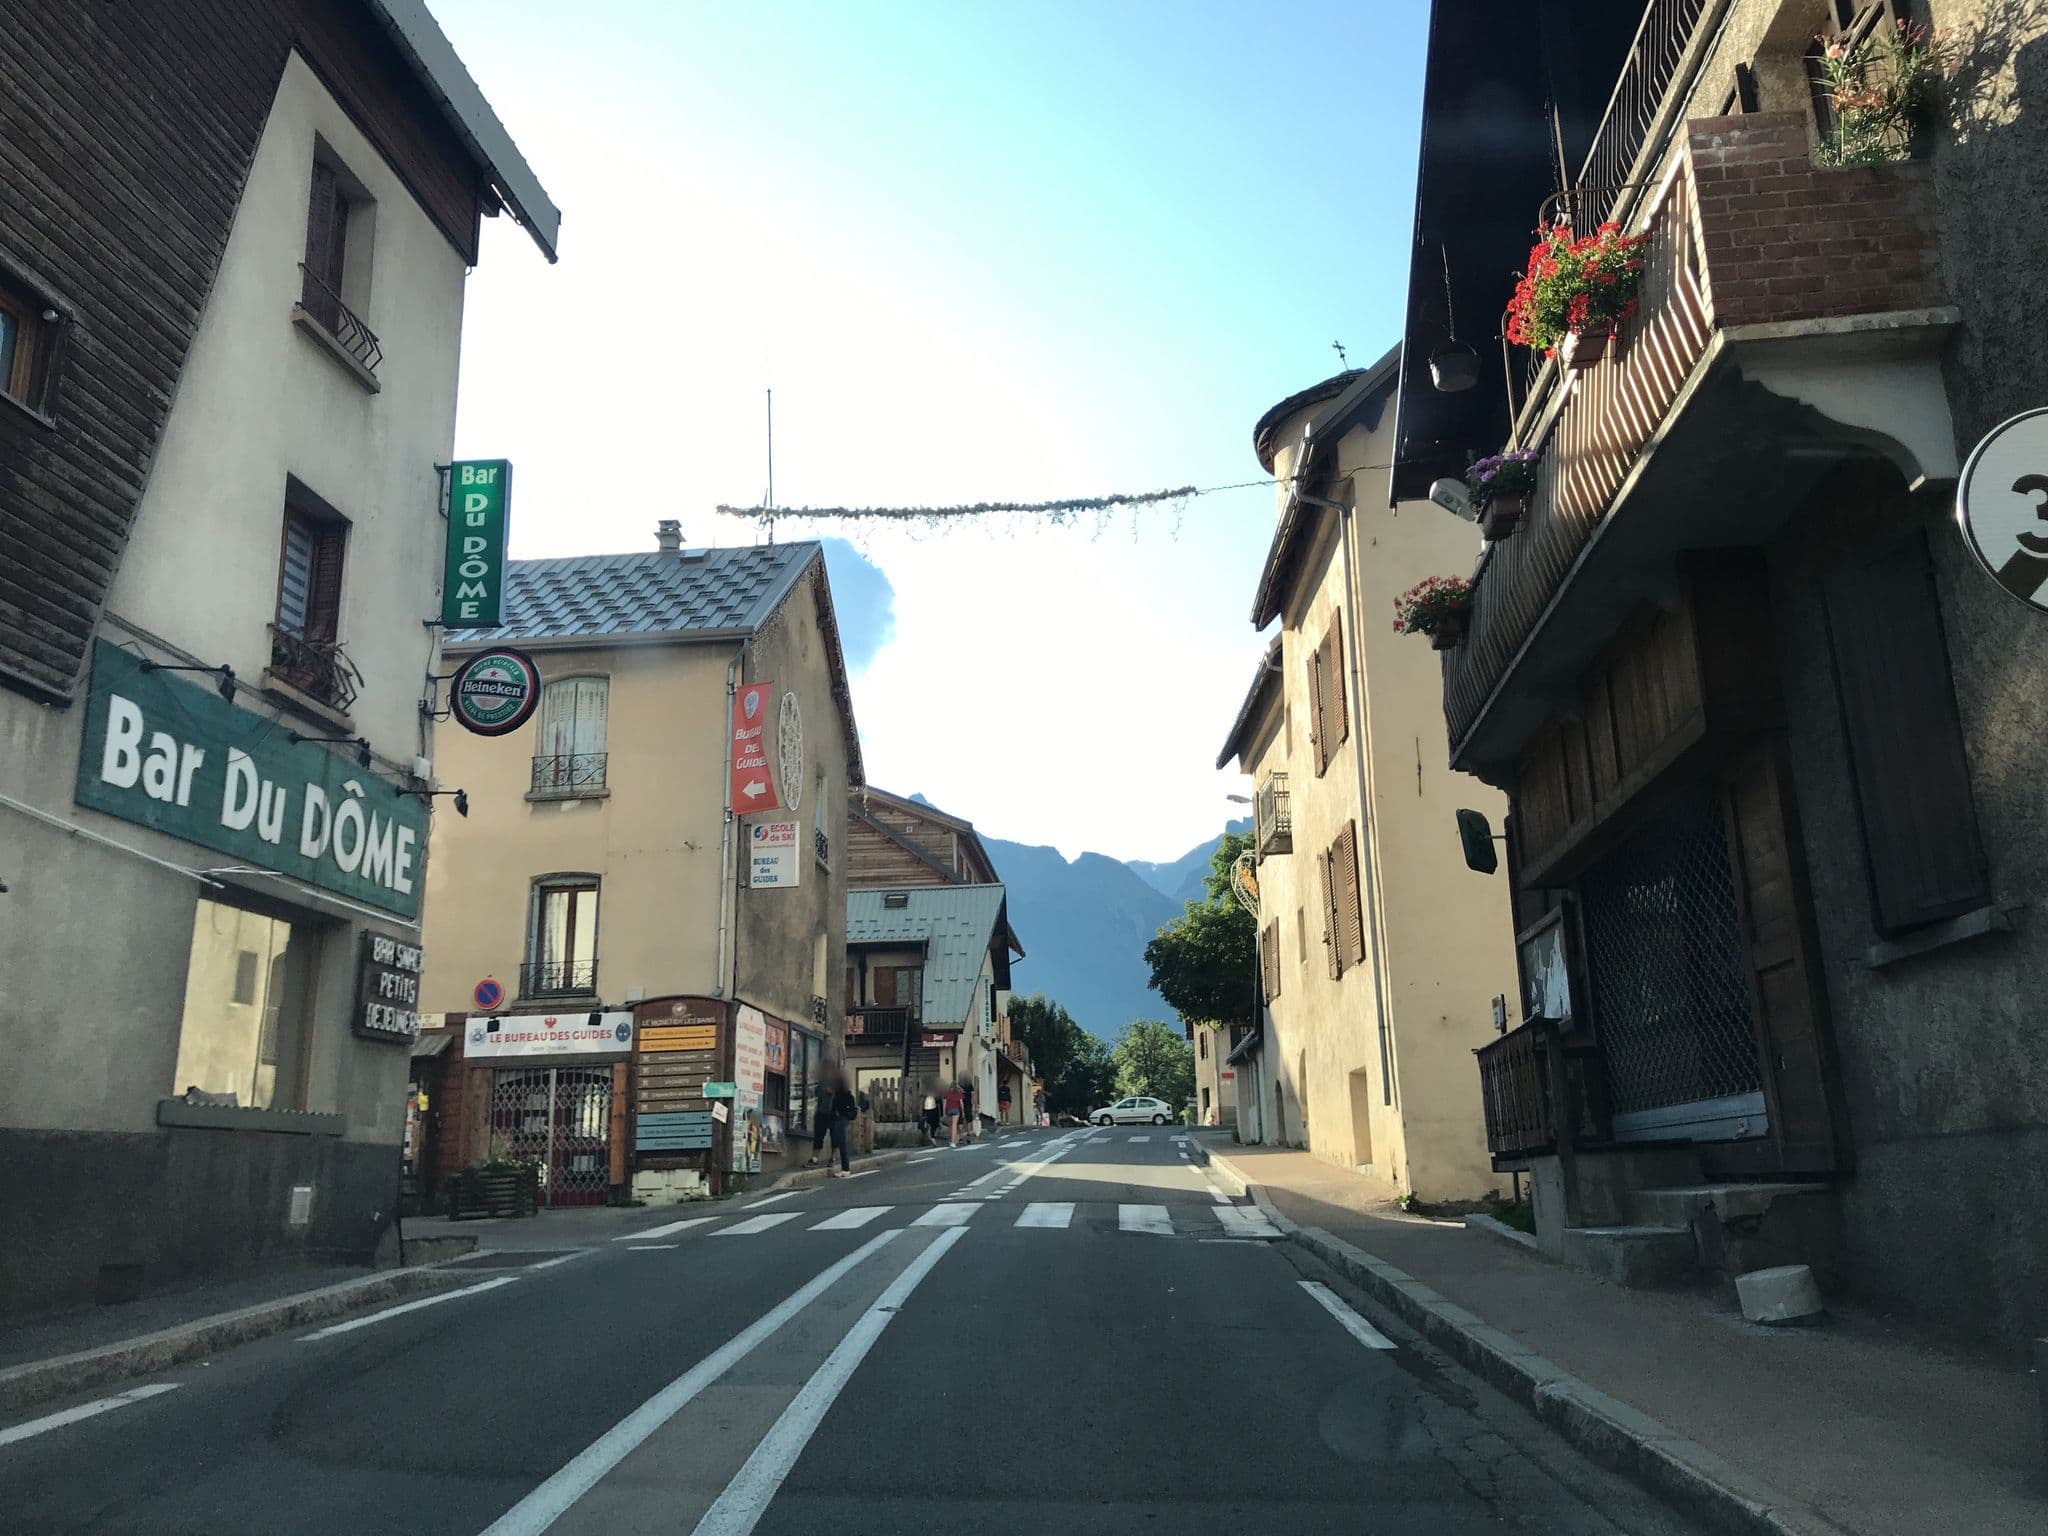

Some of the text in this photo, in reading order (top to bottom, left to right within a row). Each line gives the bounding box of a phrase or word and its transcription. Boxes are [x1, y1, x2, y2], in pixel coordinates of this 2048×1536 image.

[461, 465, 498, 485] Bar
[464, 493, 488, 527] Du
[463, 681, 521, 697] Heineken
[101, 693, 416, 895] Bar Du DÔME
[781, 832, 795, 840] SKI
[753, 857, 779, 865] BUREAU
[753, 875, 778, 883] GUIDES
[373, 936, 395, 965] BAR
[490, 1029, 612, 1043] LE BUREAU DES GUIDES
